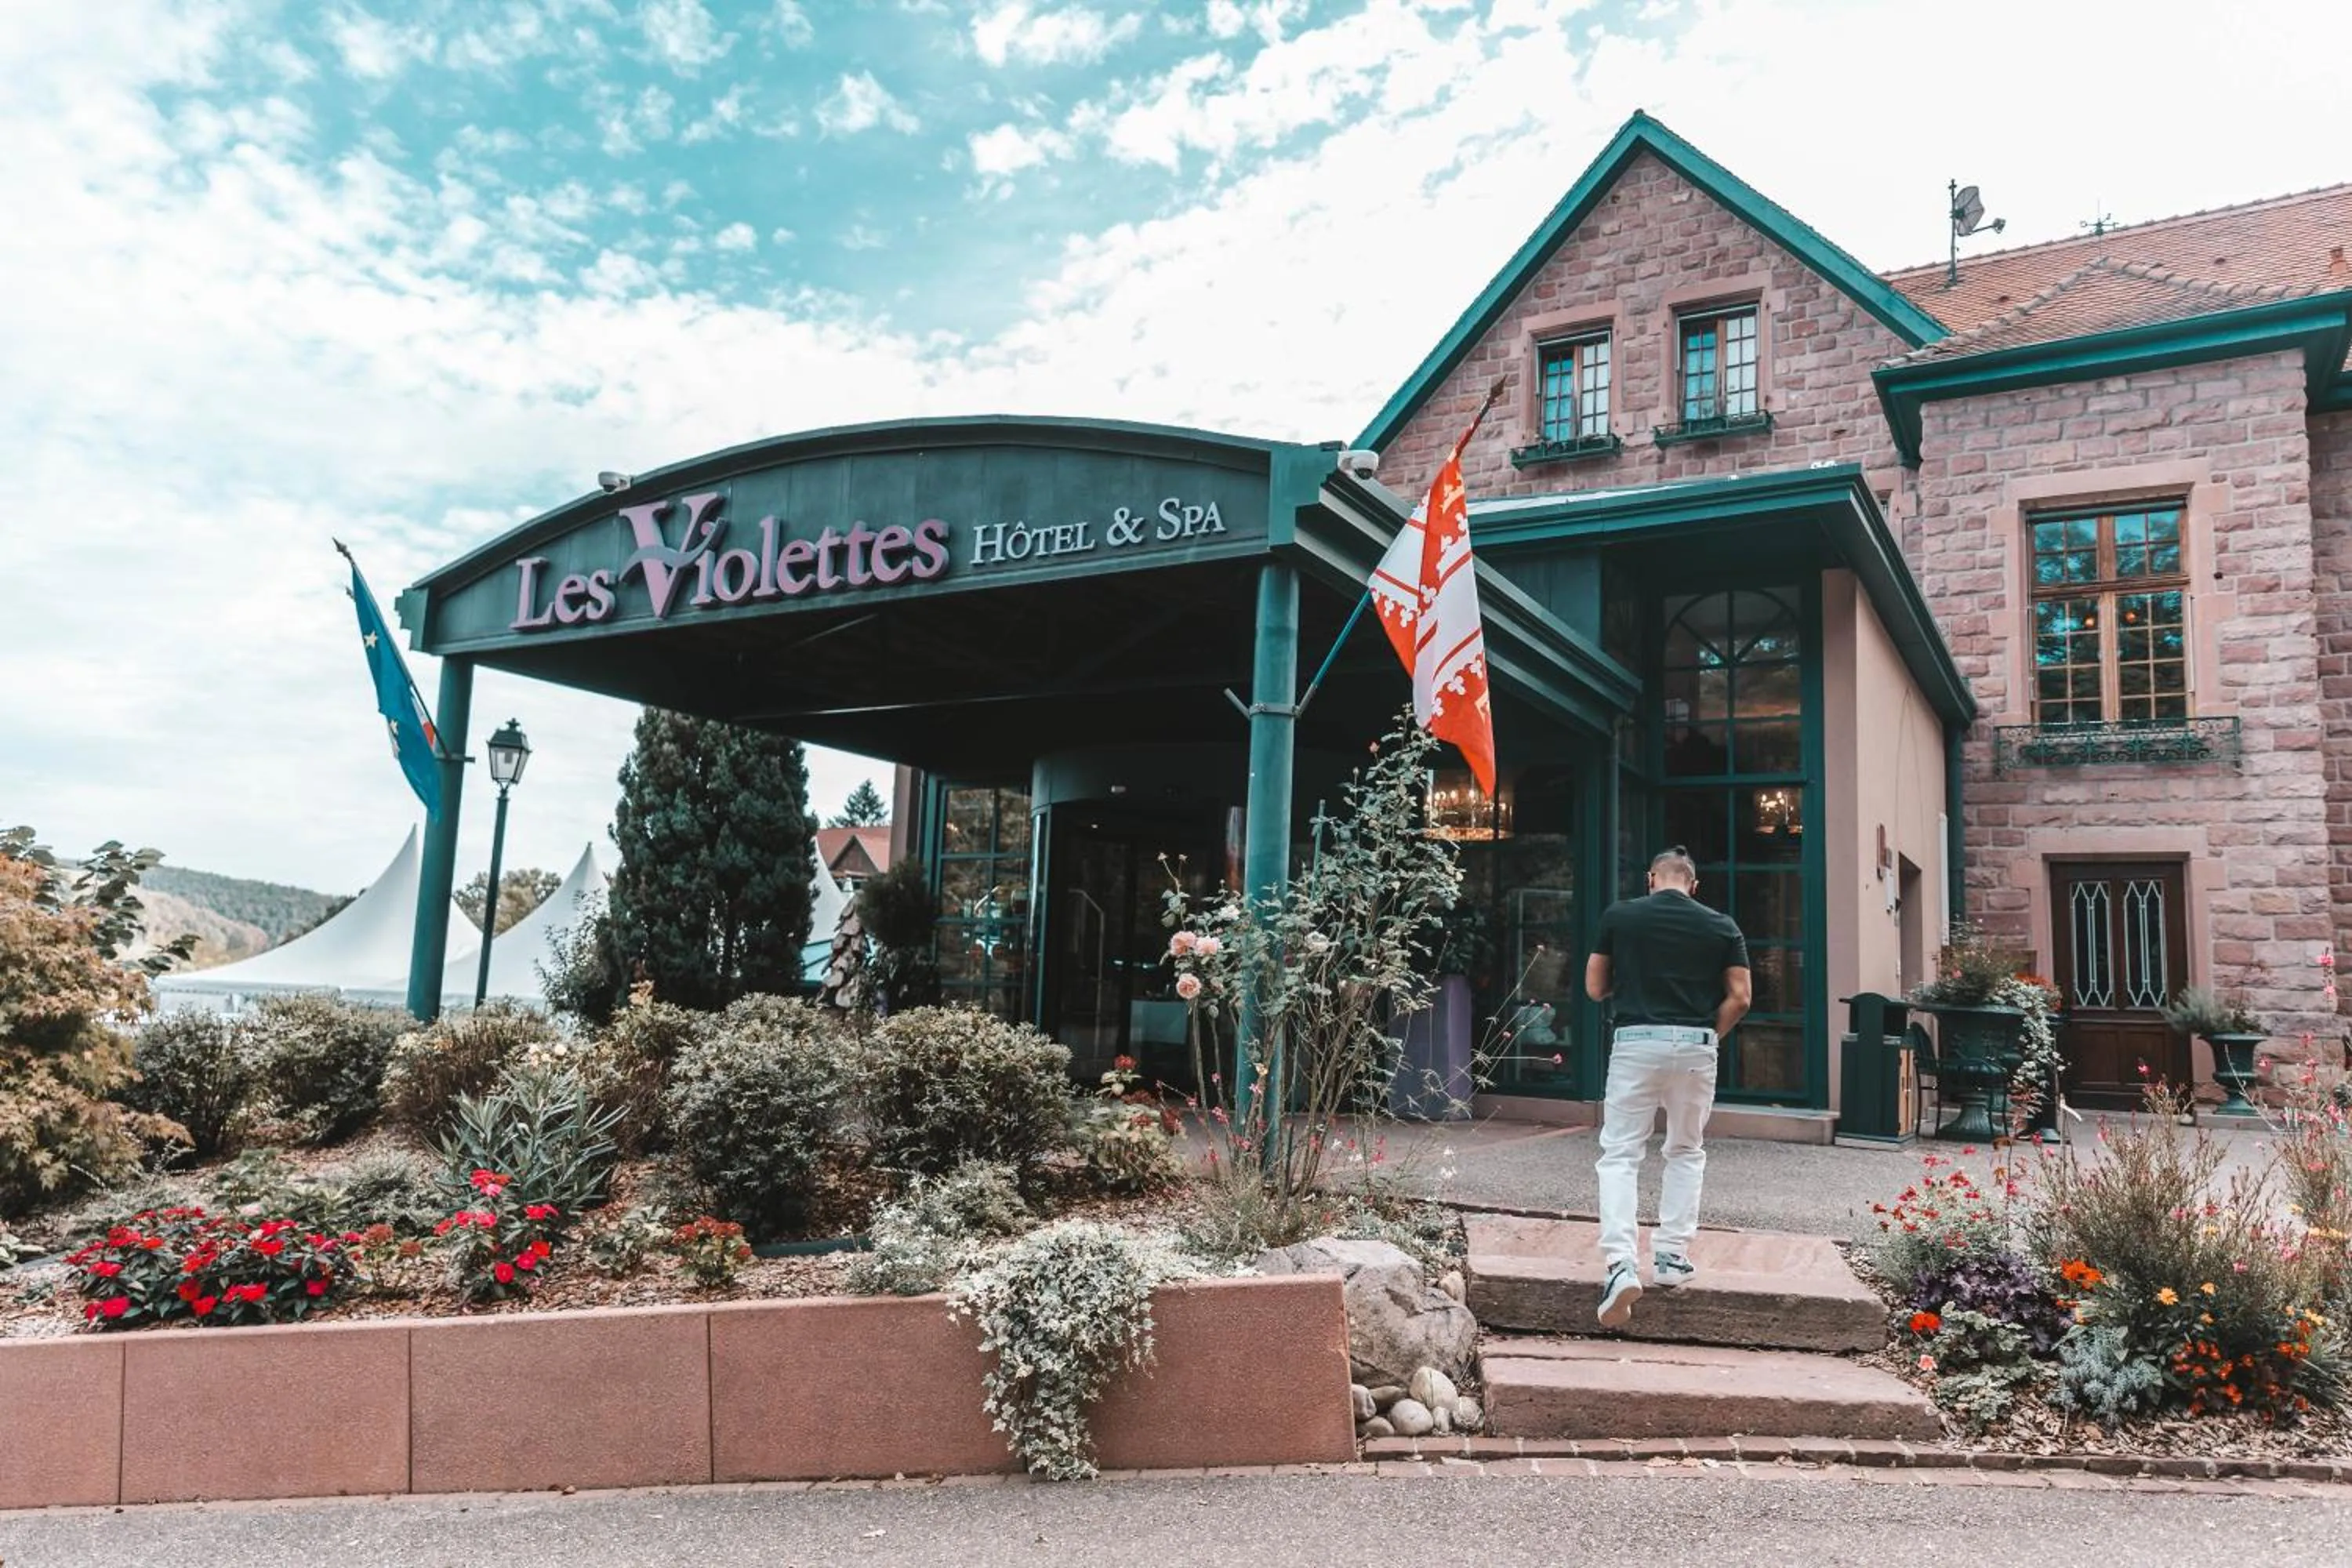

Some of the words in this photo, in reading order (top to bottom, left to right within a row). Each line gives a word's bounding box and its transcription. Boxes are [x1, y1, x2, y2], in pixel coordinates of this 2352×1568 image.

[510, 556, 617, 630] Les
[619, 492, 951, 619] Violettes
[970, 521, 1096, 564] HÔTEL
[1106, 507, 1145, 546] &
[1156, 497, 1227, 541] SPA
